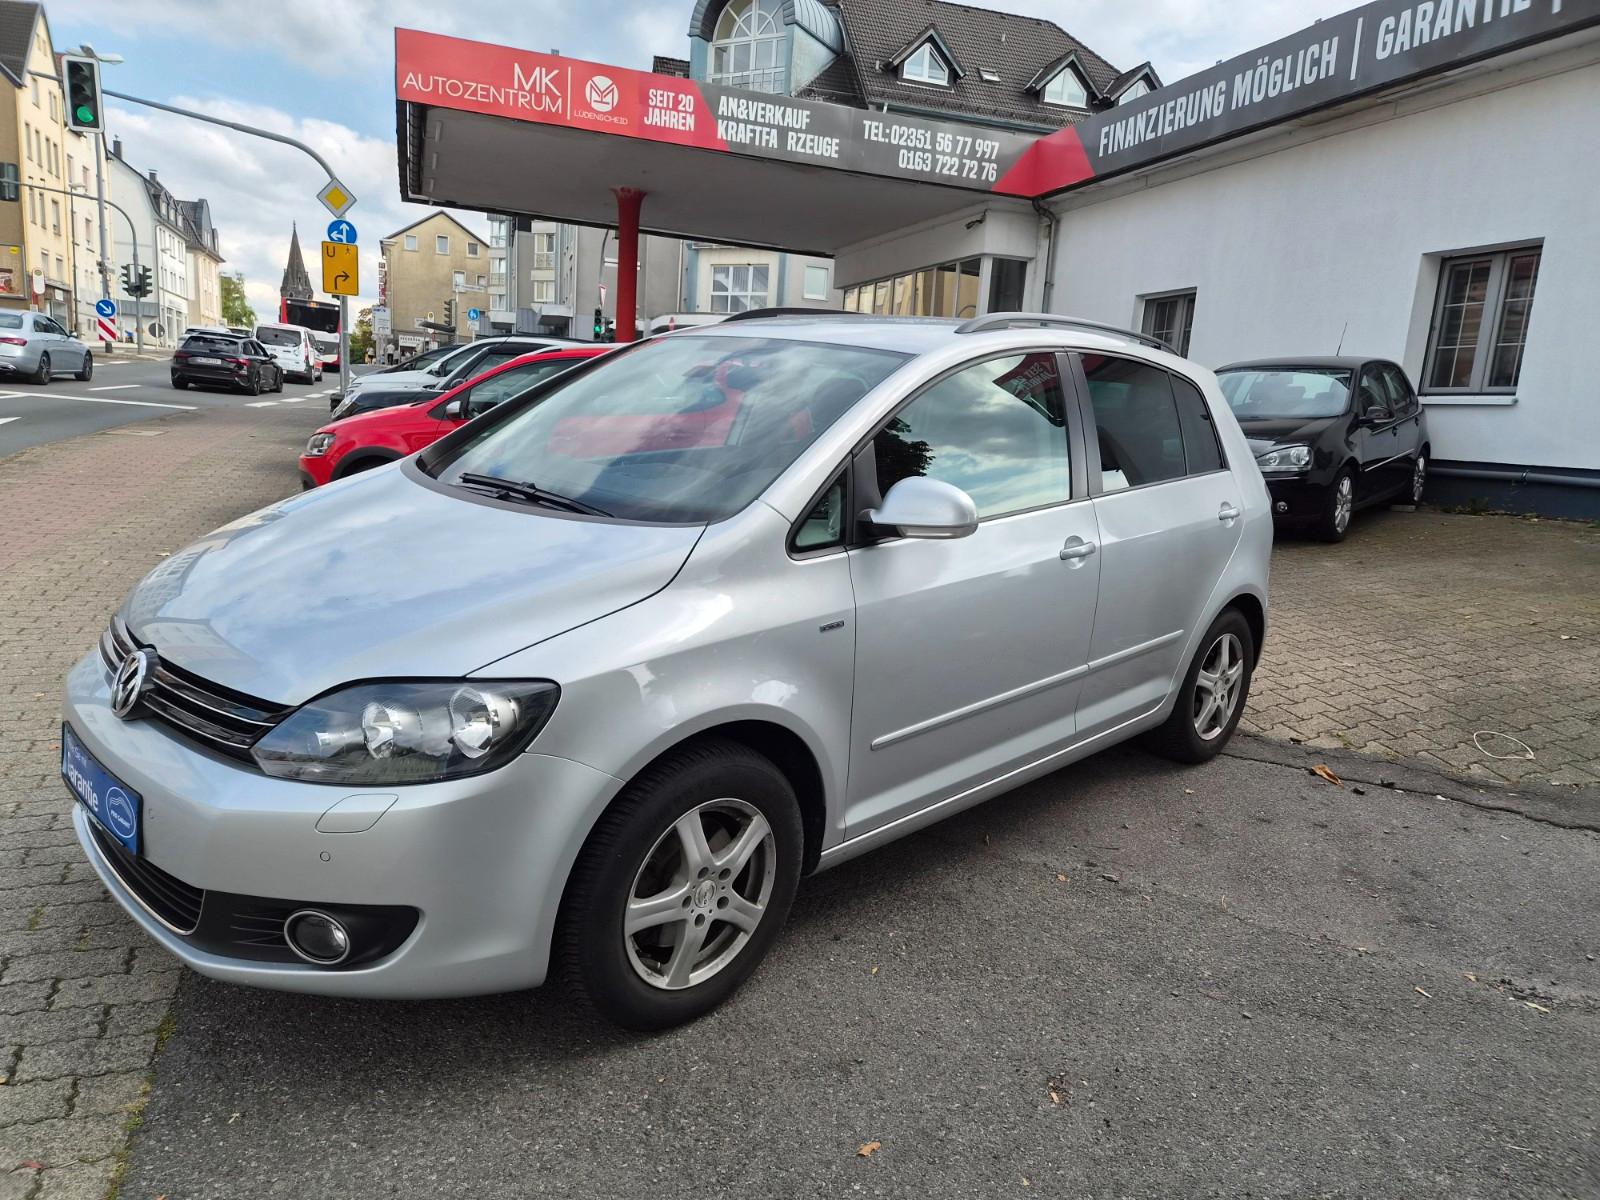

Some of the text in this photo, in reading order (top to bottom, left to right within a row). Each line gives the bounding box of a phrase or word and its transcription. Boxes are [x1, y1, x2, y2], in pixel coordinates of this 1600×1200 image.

[402, 72, 563, 114] AUTOZENTRUM
[513, 62, 560, 96] MK
[648, 88, 694, 113] SEIT 20
[718, 95, 810, 130] AN&VERKAUF
[1098, 80, 1226, 157] FINANZIERUNG
[1231, 36, 1339, 108] MÖGLICH
[644, 107, 695, 132] JAHREN
[935, 132, 953, 153] 56
[955, 136, 973, 155] 77
[975, 139, 1000, 160] 997
[898, 149, 997, 182] 0163 722 72 76
[326, 245, 336, 258] U
